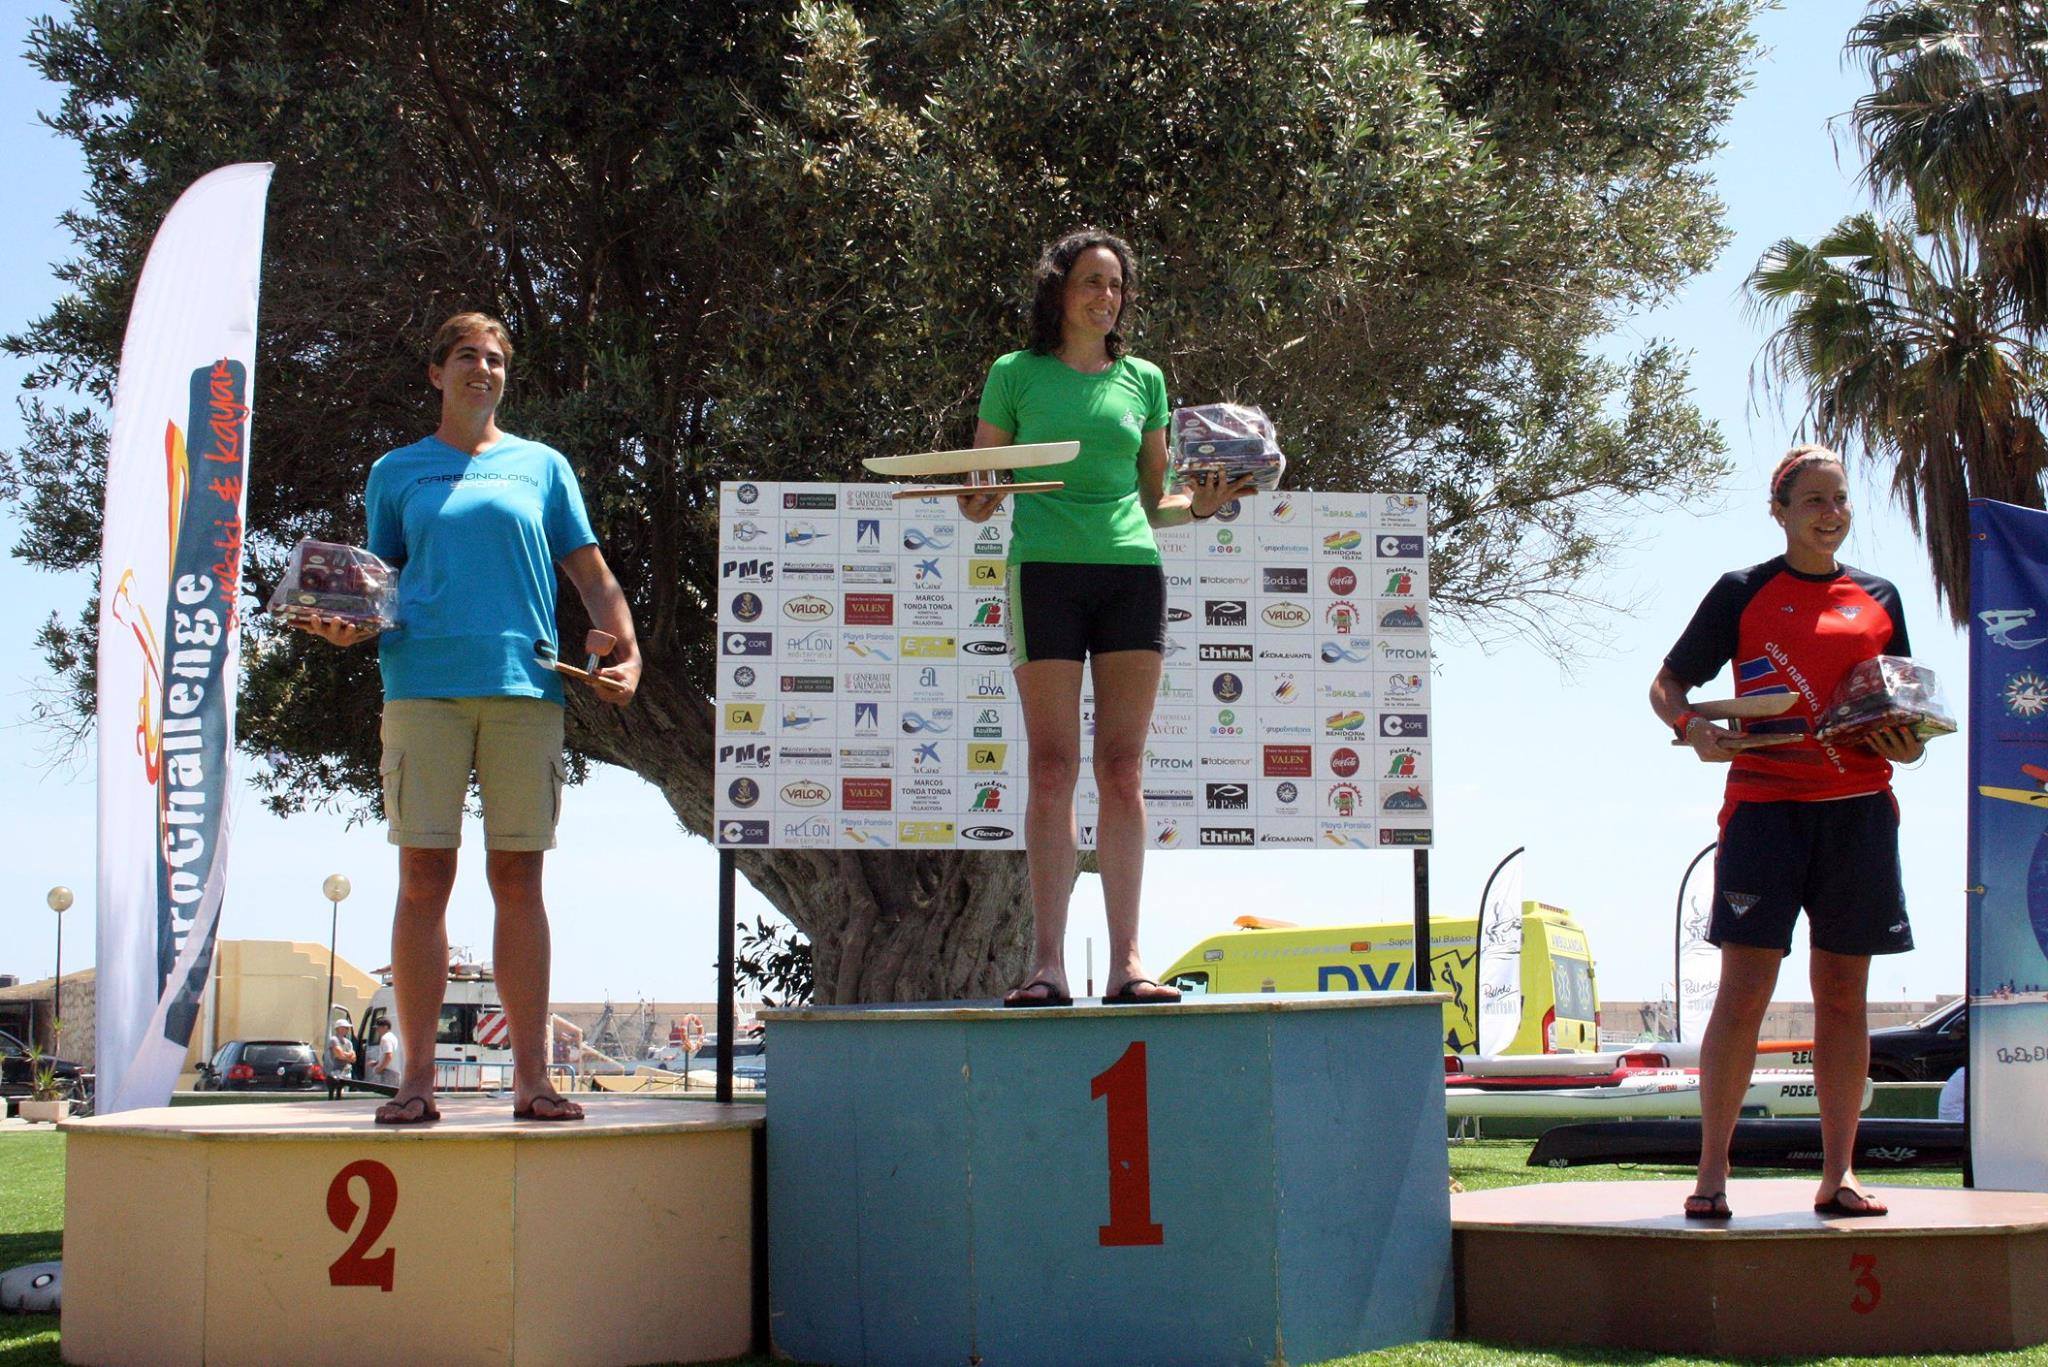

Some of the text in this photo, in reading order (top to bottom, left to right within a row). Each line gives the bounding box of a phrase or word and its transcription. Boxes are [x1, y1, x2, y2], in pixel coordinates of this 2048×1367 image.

[204, 356, 250, 464] kayak
[417, 473, 539, 487] CARBONOLOGY
[1400, 543, 1419, 551] COPE
[976, 566, 997, 580] GA
[788, 603, 828, 615] VALOR
[852, 602, 885, 612] VALEN
[1266, 610, 1306, 621] VALOR
[748, 640, 768, 648] COPE
[976, 644, 1005, 652] Reed
[1200, 646, 1252, 659] think
[1765, 641, 1789, 667] club
[1786, 665, 1819, 712] natació
[979, 685, 1005, 695] DYA
[732, 710, 753, 724] GA
[1404, 722, 1422, 730] COPE
[975, 750, 996, 764] GA
[1271, 754, 1304, 764] VALEN
[1151, 758, 1192, 769] PROM
[785, 788, 826, 801] VALOR
[849, 788, 884, 798] VALEN
[744, 828, 764, 837] COPE
[976, 830, 1004, 838] Reed
[1201, 831, 1253, 844] think
[1091, 1041, 1164, 1246] 1
[326, 1159, 398, 1292] 2
[1849, 1254, 1882, 1315] 3
